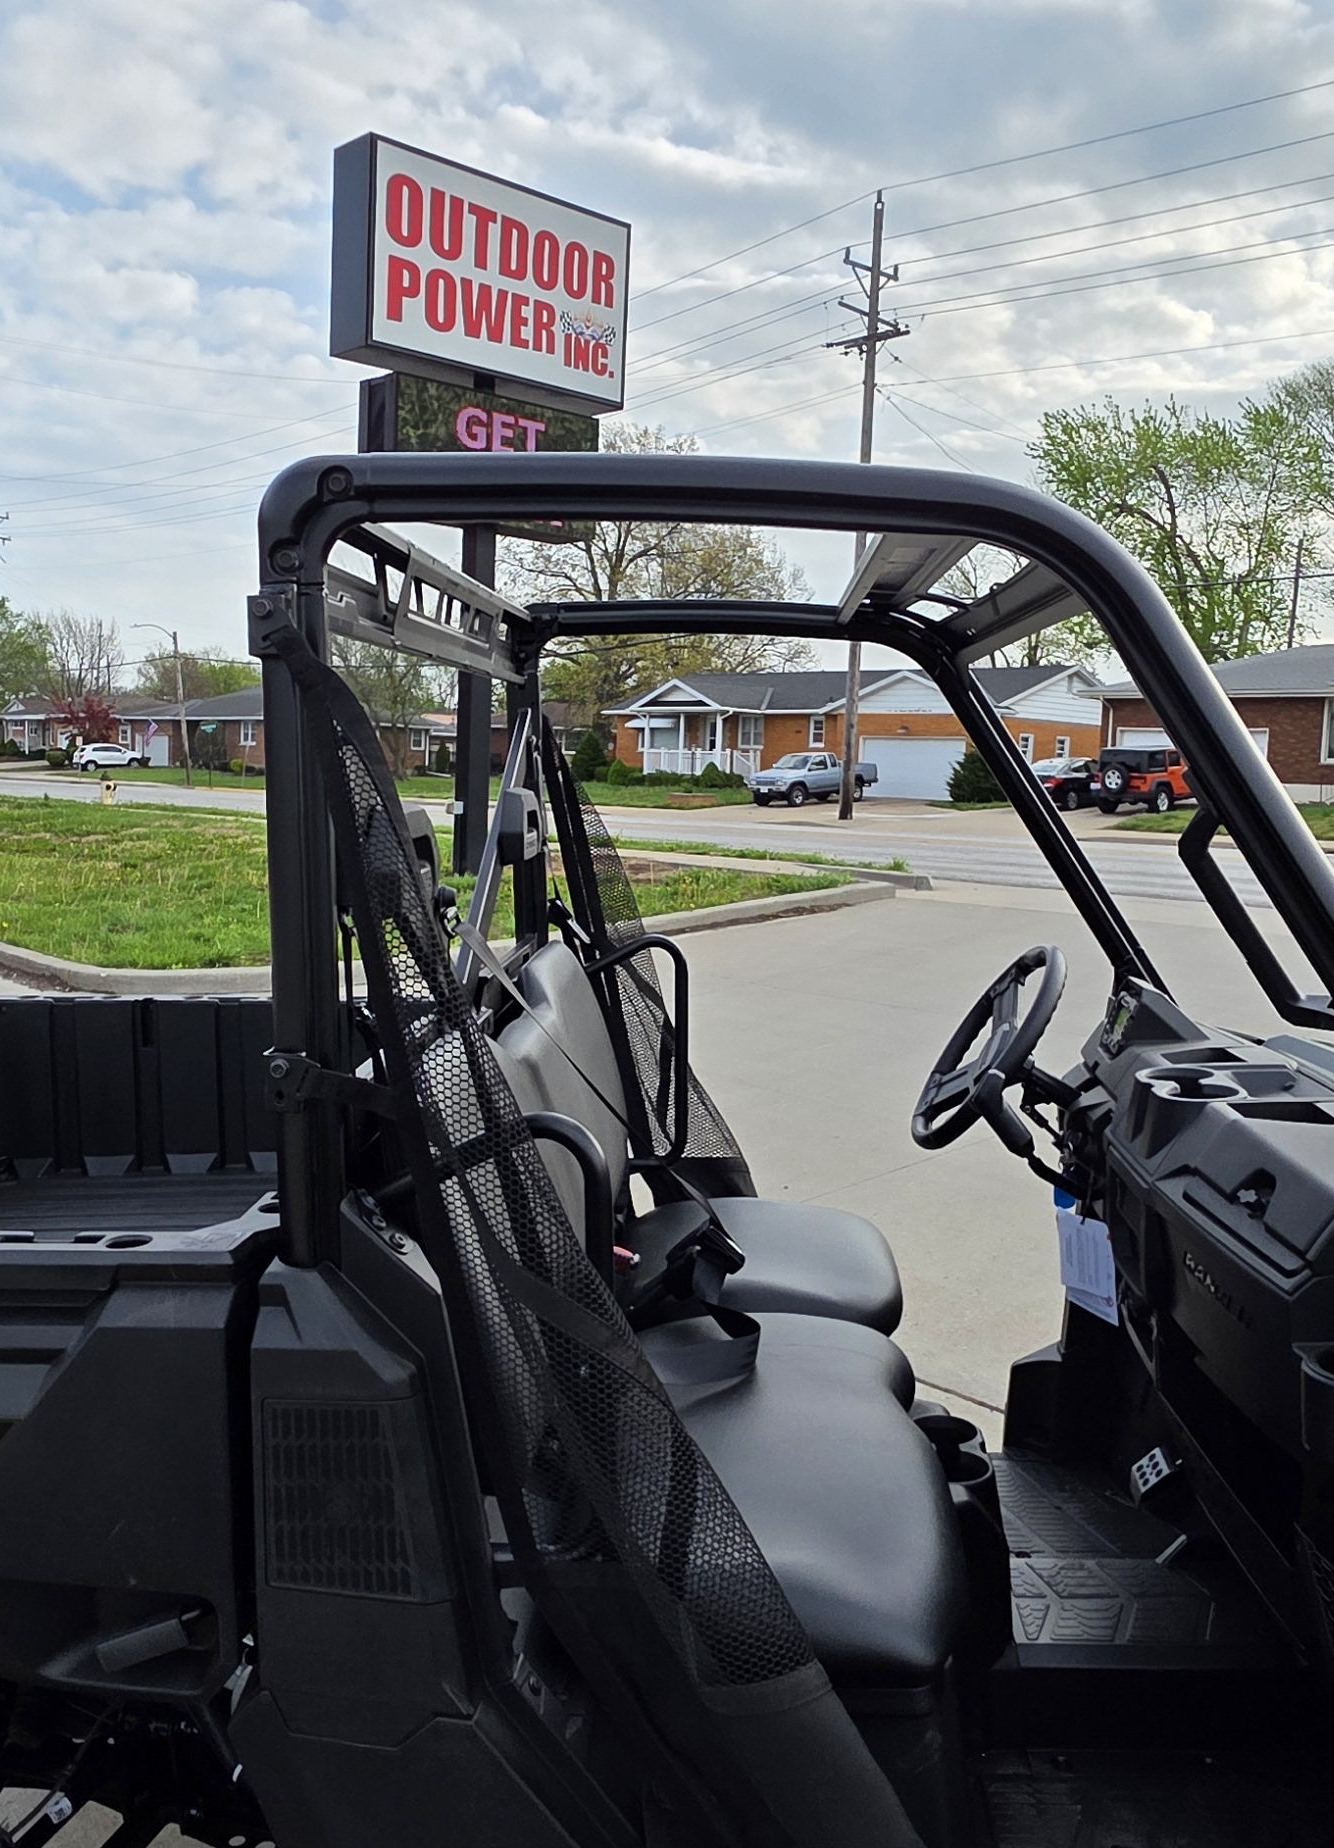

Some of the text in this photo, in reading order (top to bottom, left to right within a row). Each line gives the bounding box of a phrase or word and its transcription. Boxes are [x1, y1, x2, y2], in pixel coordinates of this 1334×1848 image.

[385, 173, 616, 309] OUTDOOR
[386, 254, 615, 379] POWER INC.
[455, 406, 546, 452] GET
